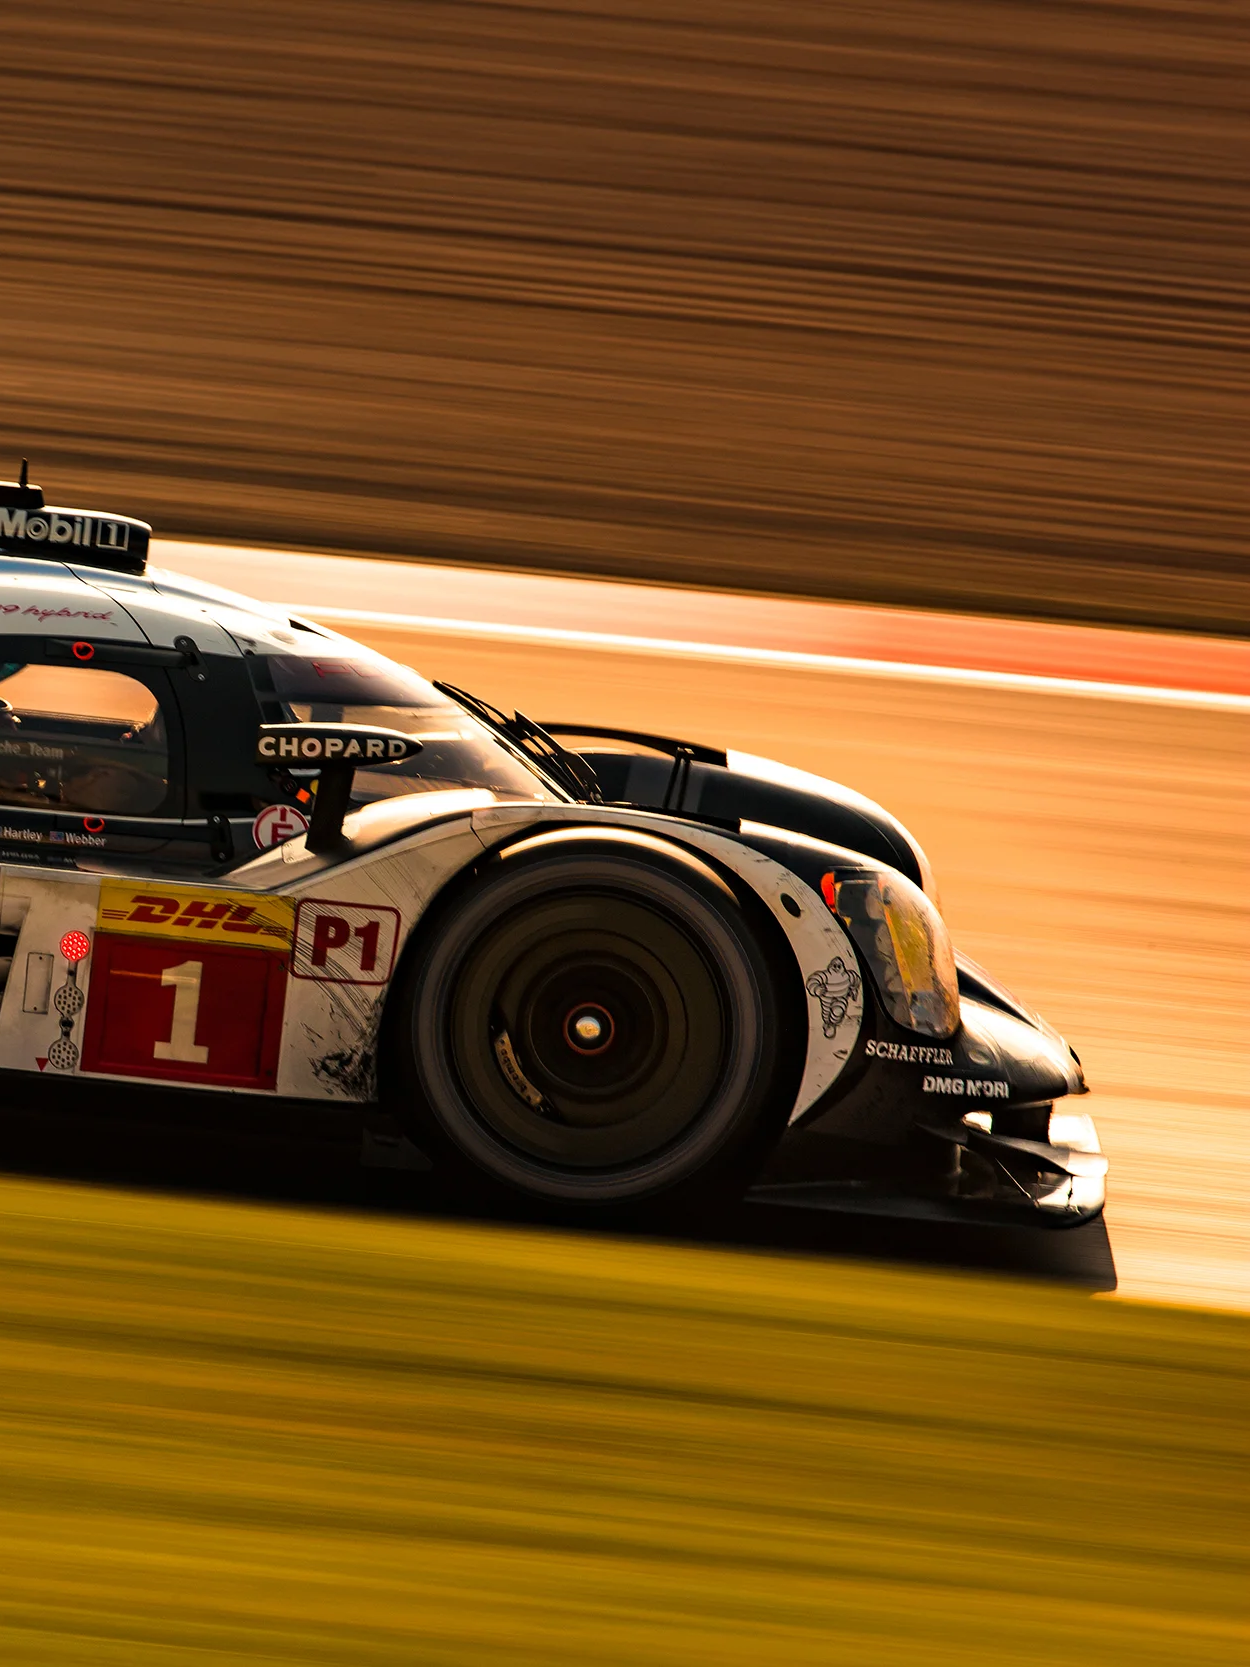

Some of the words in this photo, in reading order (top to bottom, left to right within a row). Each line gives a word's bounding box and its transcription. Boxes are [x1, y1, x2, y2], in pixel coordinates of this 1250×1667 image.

[21, 605, 114, 622] hybrid
[258, 736, 407, 758] CHOPARD
[3, 826, 44, 843] Hartley
[64, 831, 107, 848] Webber
[127, 895, 262, 934] DHL
[311, 914, 380, 972] P1
[152, 959, 210, 1065] 1
[864, 1038, 955, 1066] SCHAEFFLER
[921, 1074, 965, 1096] DMG
[965, 1078, 1010, 1099] MORI
